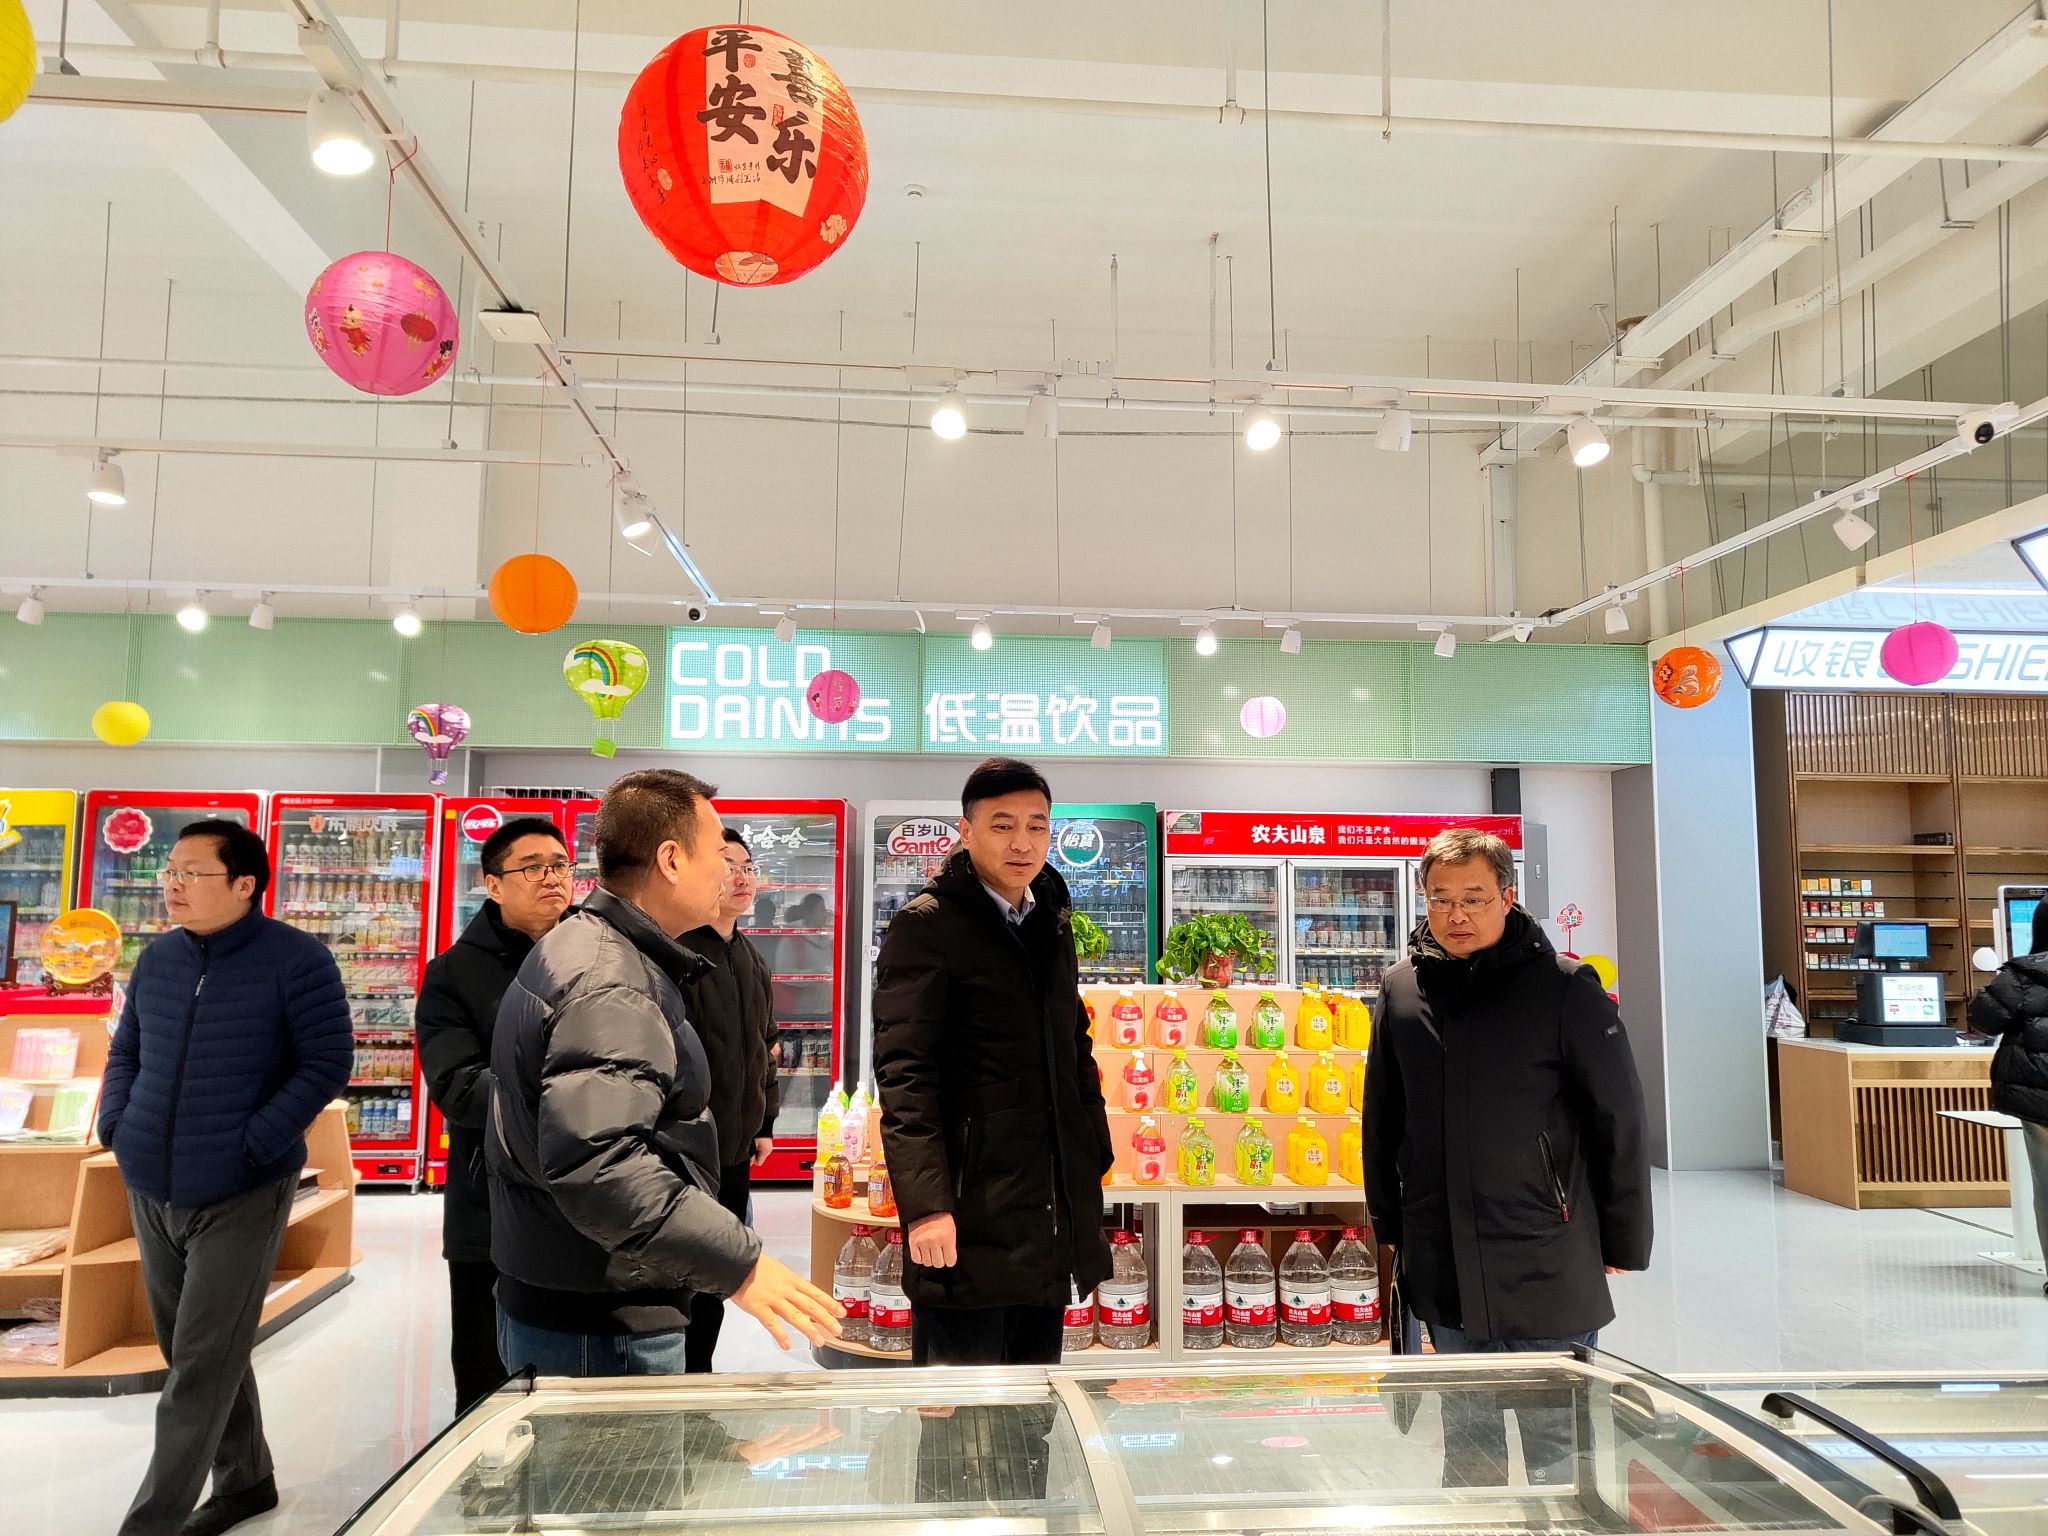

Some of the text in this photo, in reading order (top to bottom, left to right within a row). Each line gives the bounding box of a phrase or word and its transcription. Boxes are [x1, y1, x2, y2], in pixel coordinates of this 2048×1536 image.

[696, 29, 767, 145] 平安
[671, 641, 831, 688] COLD
[1773, 639, 2048, 682] 收银 SHIE
[924, 691, 1161, 747] 低温饮品
[901, 823, 948, 837] 百岁山
[1250, 824, 1326, 845] 农夫山泉
